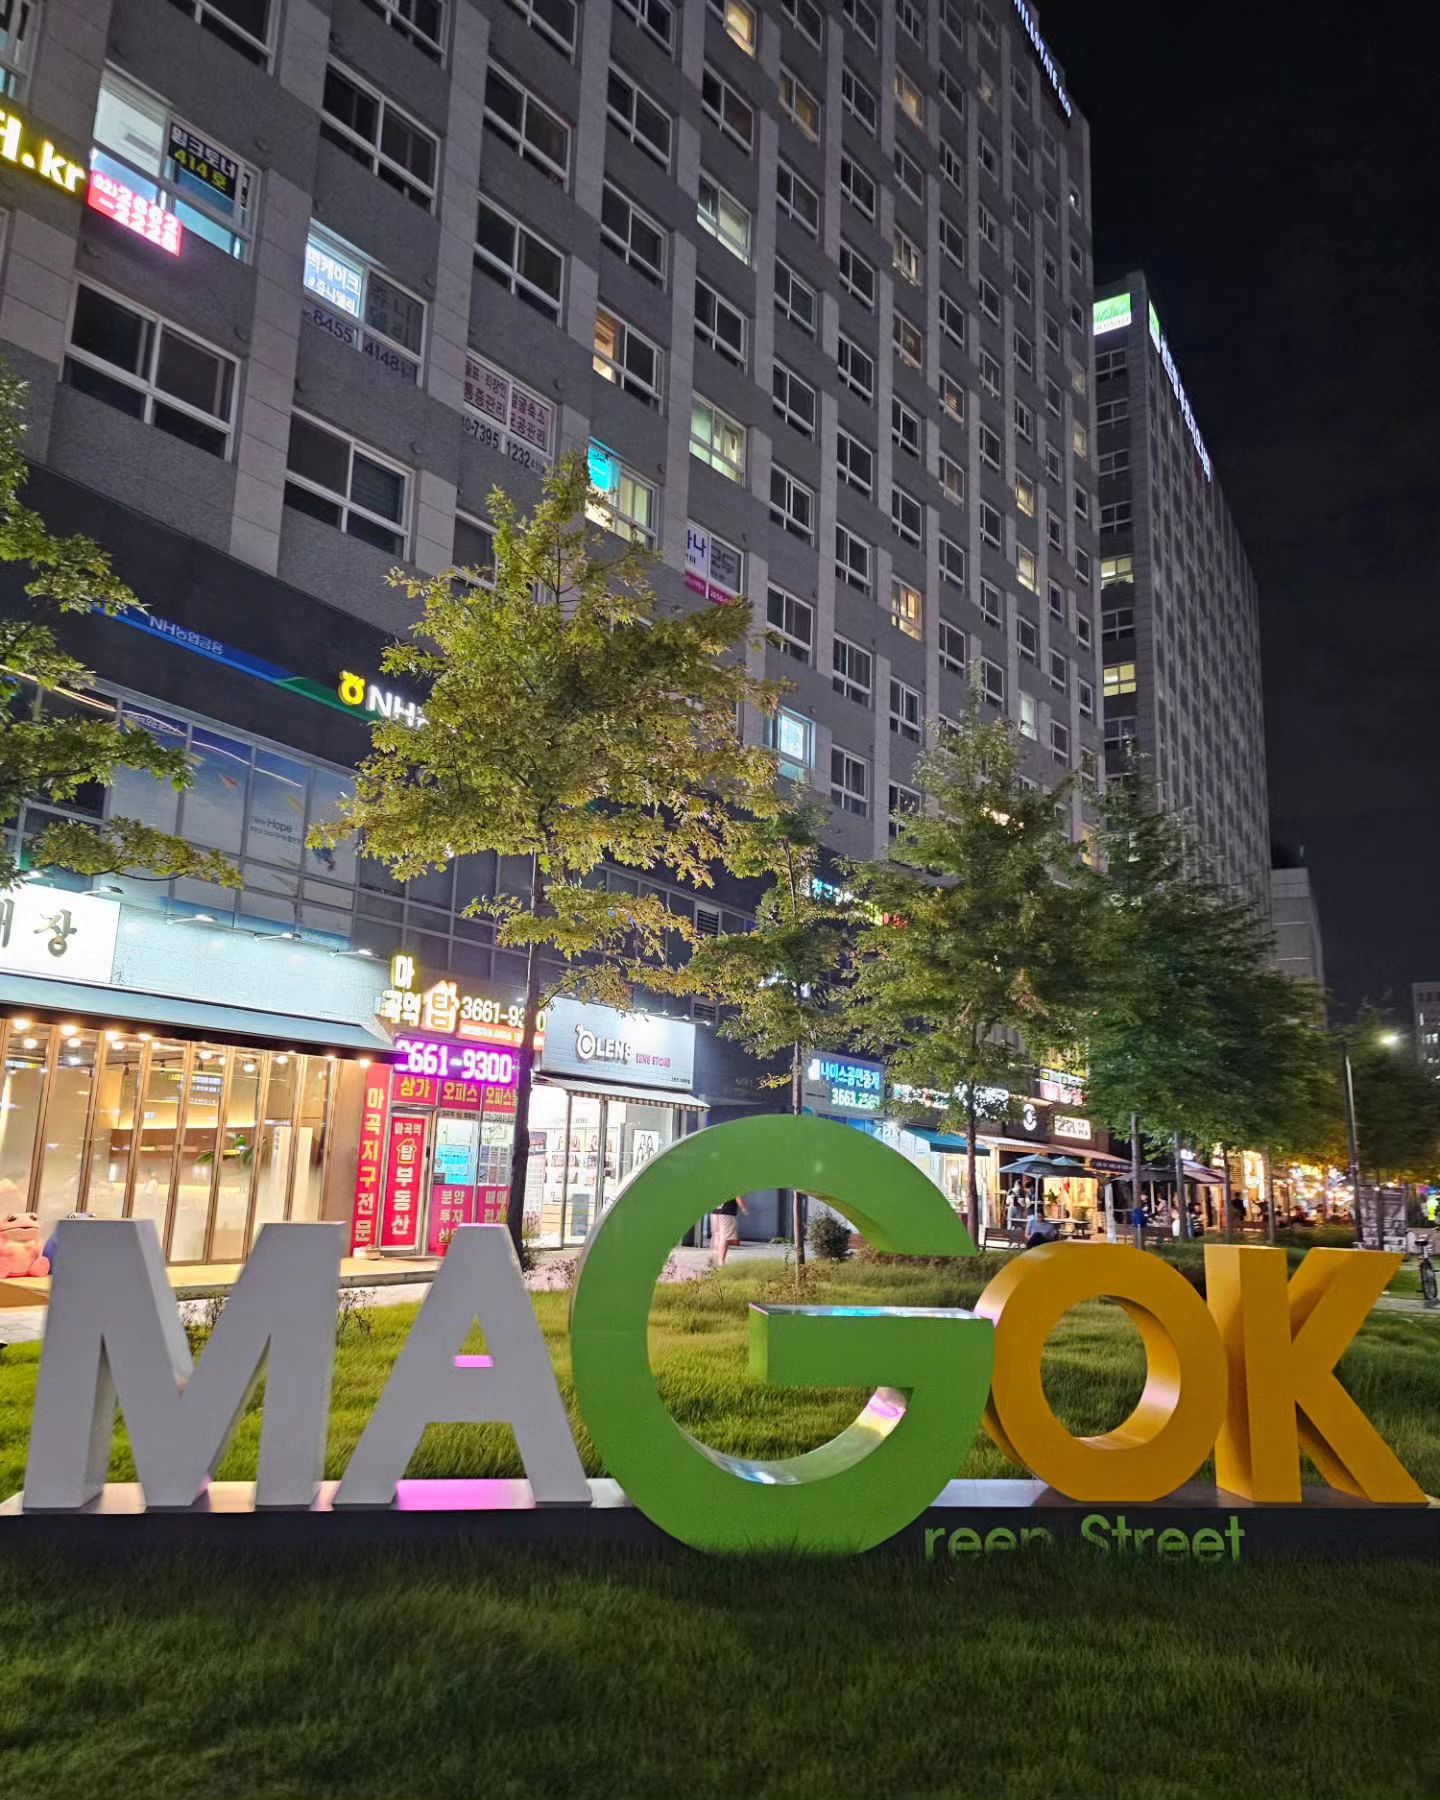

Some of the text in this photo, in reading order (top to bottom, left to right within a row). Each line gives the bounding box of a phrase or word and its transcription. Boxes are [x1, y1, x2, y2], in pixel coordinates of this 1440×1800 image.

[170, 124, 236, 177] 잉크토너
[312, 309, 353, 344] 8455
[507, 441, 531, 469] 1232
[365, 684, 430, 730] NH
[267, 818, 293, 833] Hope
[460, 995, 548, 1033] 3661-930
[400, 1076, 431, 1099] 상가
[442, 1082, 478, 1103] 오피스
[394, 1121, 422, 1136] 마곡역
[391, 1166, 415, 1236] 부동산
[441, 1189, 466, 1205] 분양
[438, 1208, 464, 1225] 투자
[22, 1114, 1429, 1556] MAGOK
[1080, 1513, 1246, 1562] Street
